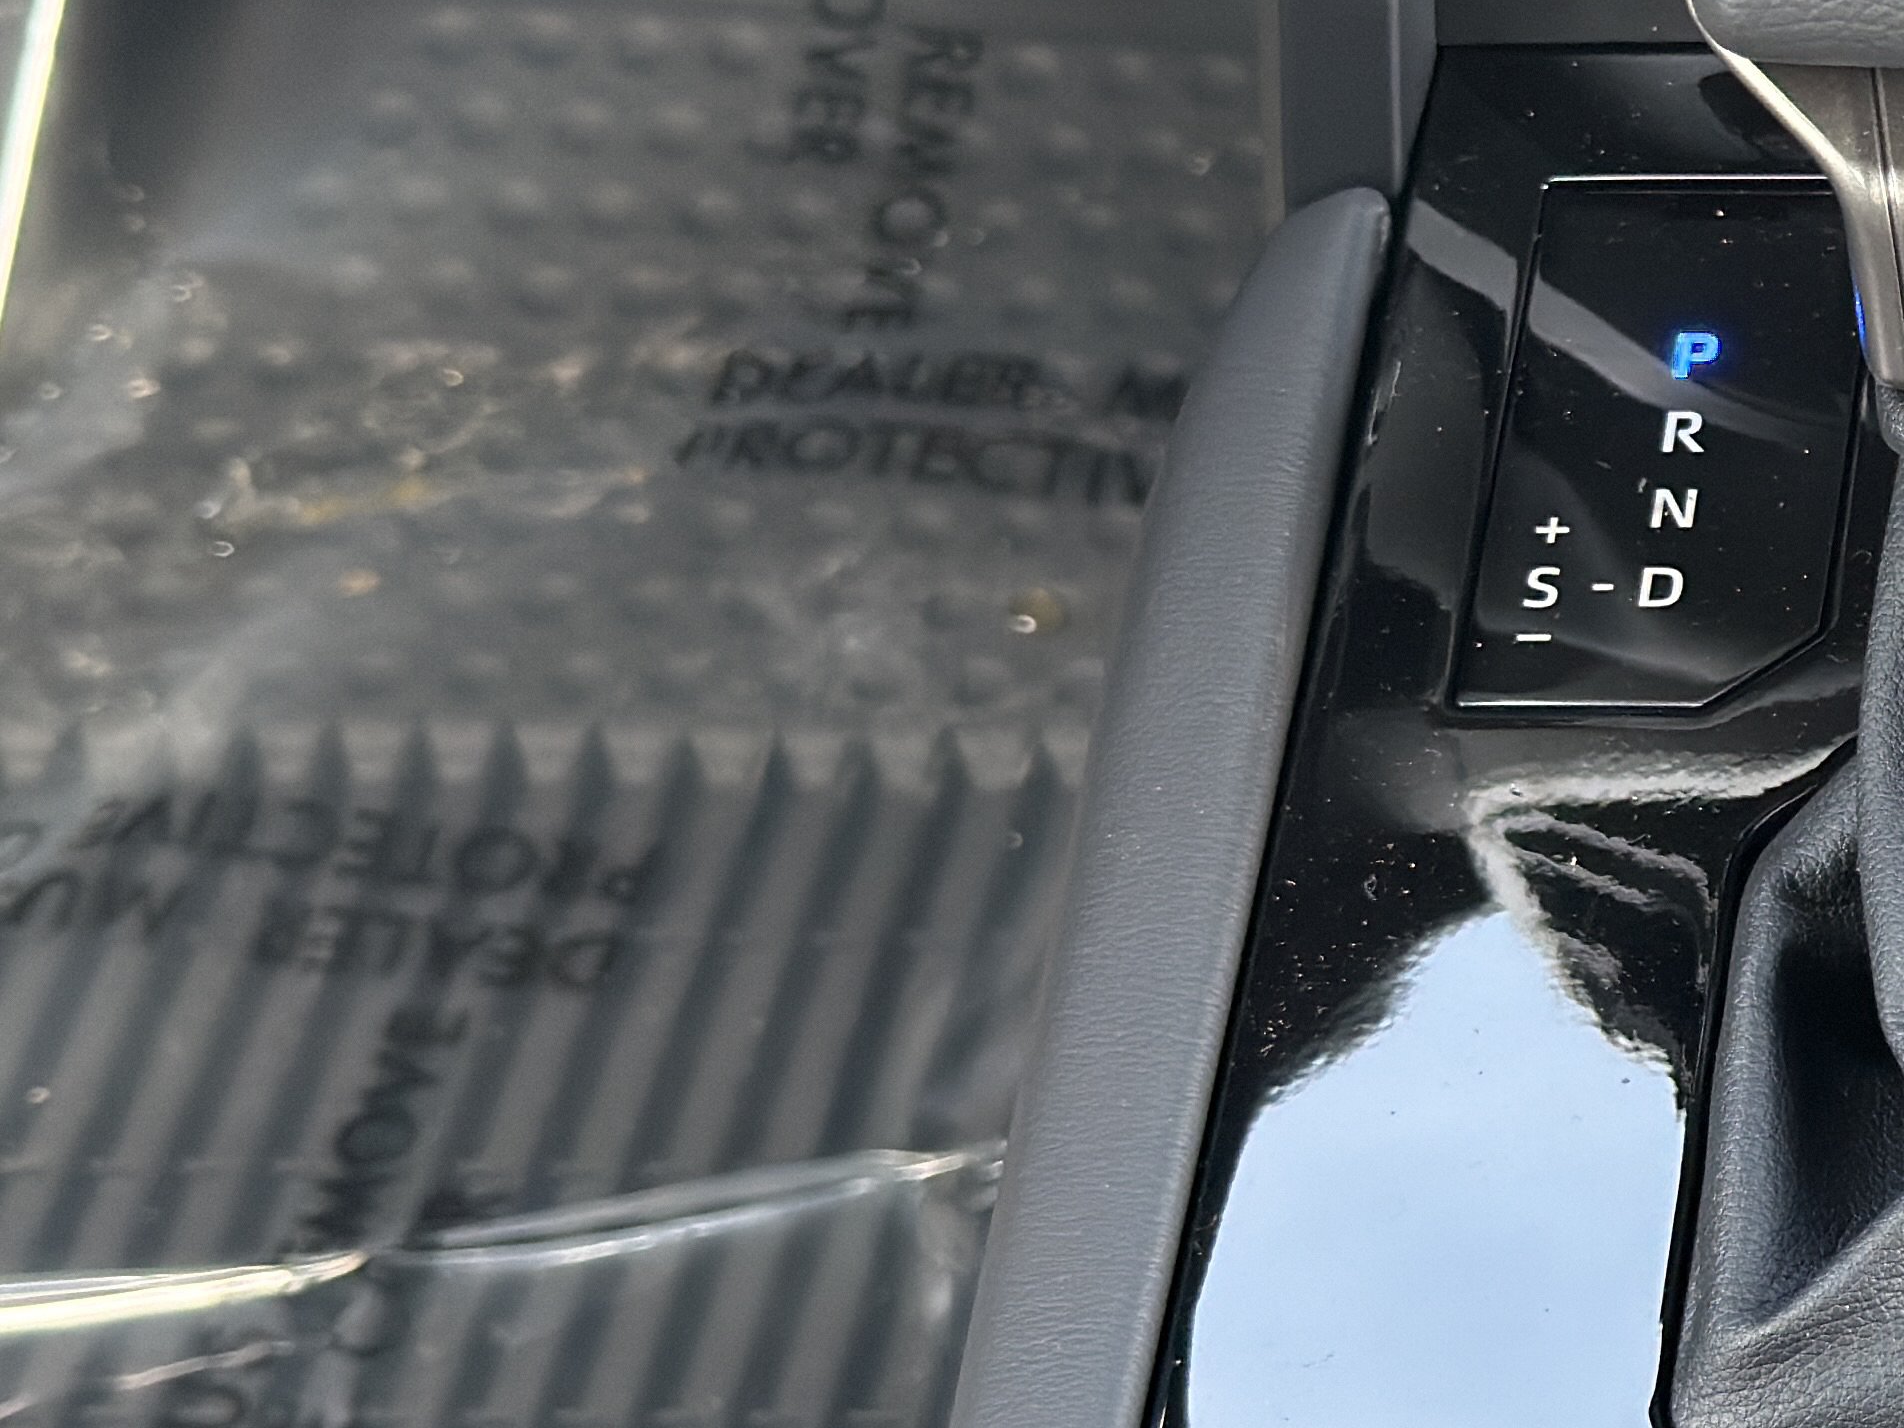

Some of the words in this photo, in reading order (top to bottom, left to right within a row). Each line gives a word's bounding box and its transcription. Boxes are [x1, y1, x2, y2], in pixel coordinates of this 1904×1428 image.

[1670, 331, 1721, 380] P
[1660, 410, 1705, 453] R
[1649, 488, 1698, 529] N
[1522, 566, 1561, 609] S
[1637, 566, 1684, 608] D
